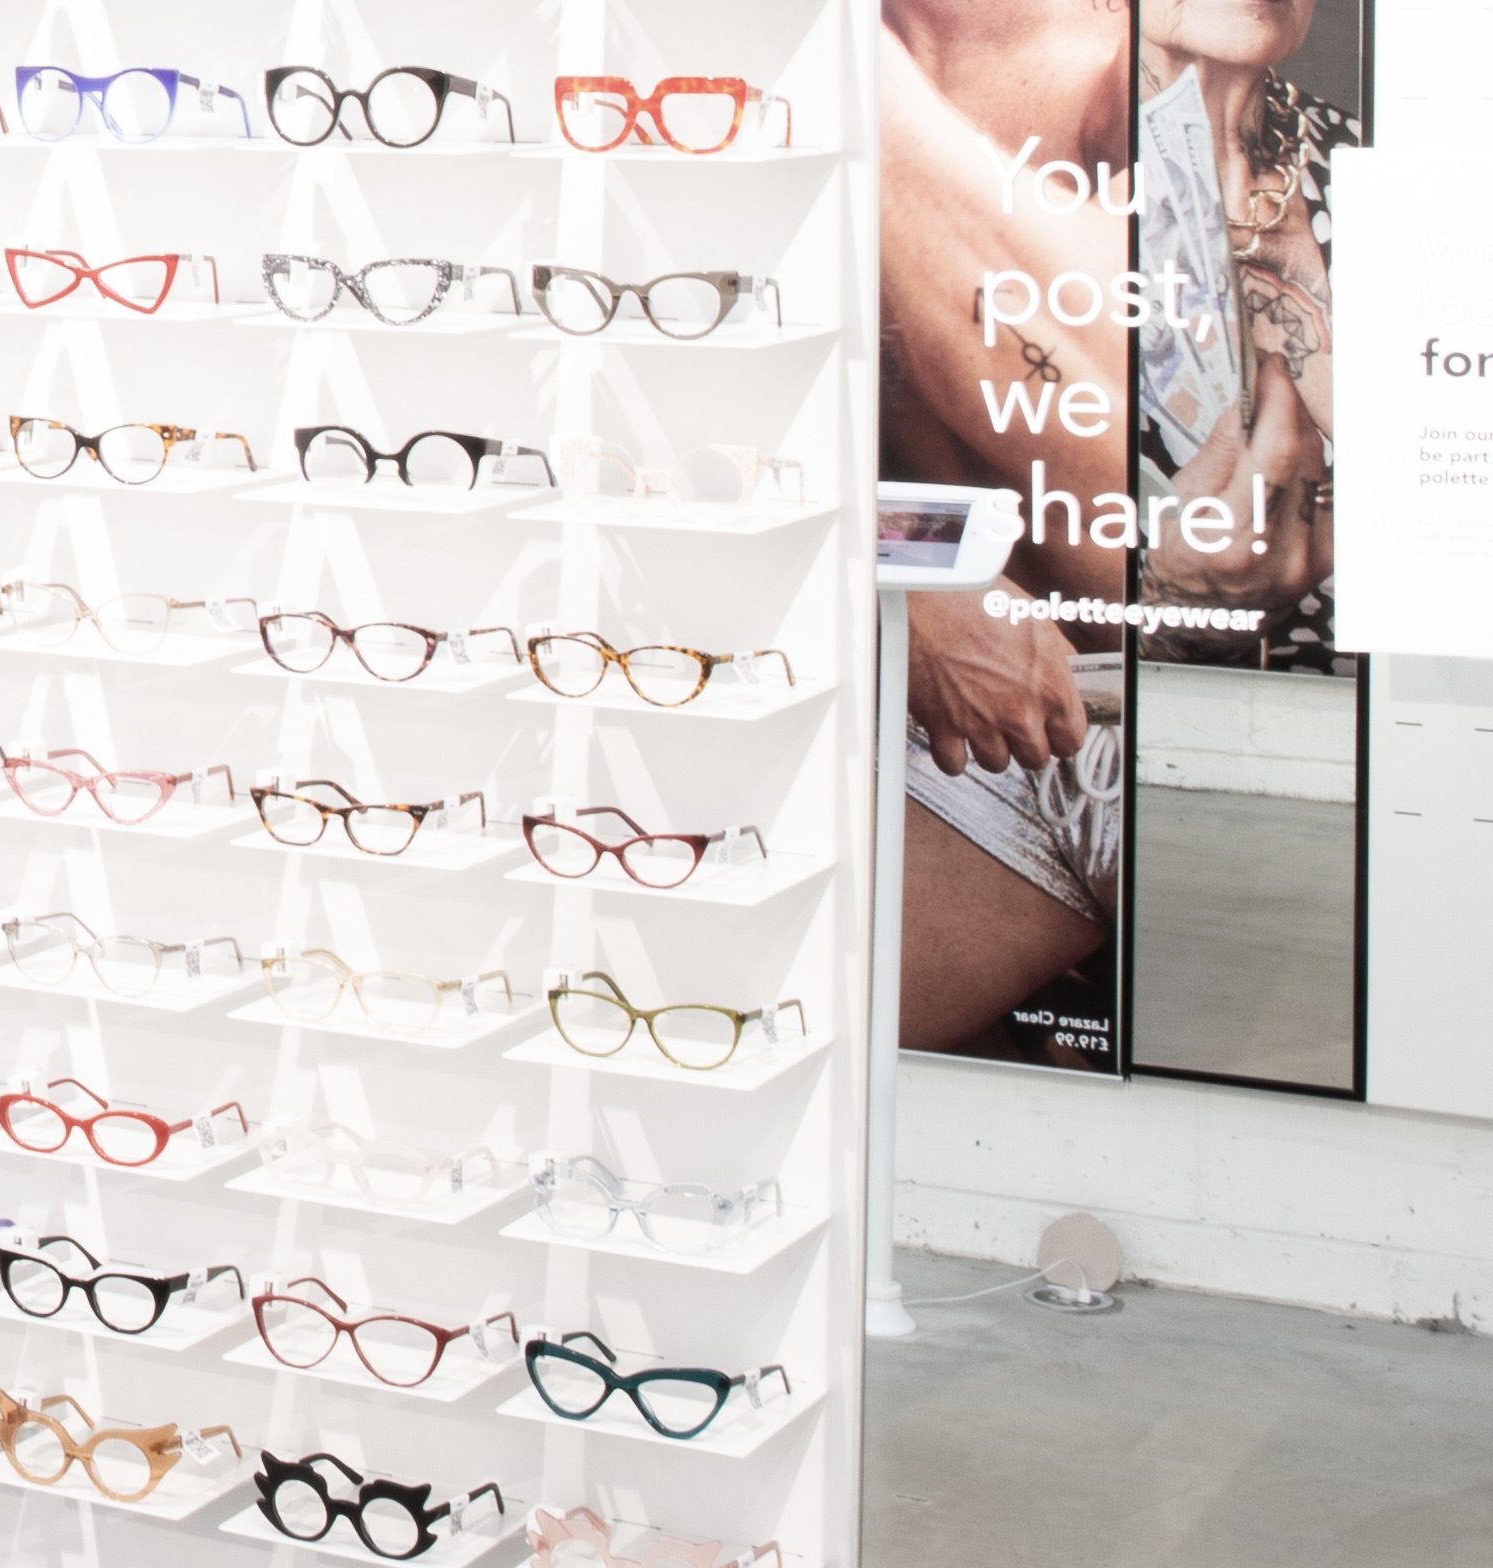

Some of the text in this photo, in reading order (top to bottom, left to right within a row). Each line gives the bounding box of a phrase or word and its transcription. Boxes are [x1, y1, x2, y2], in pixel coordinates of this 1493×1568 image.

[980, 134, 1146, 216] You
[982, 259, 1214, 348] post,
[979, 378, 1112, 438] we
[1419, 425, 1493, 441] Join ou
[1420, 447, 1489, 466] be part
[1420, 469, 1489, 487] polette
[984, 459, 1269, 556] share!
[982, 589, 1265, 635] @poletteeyewear
